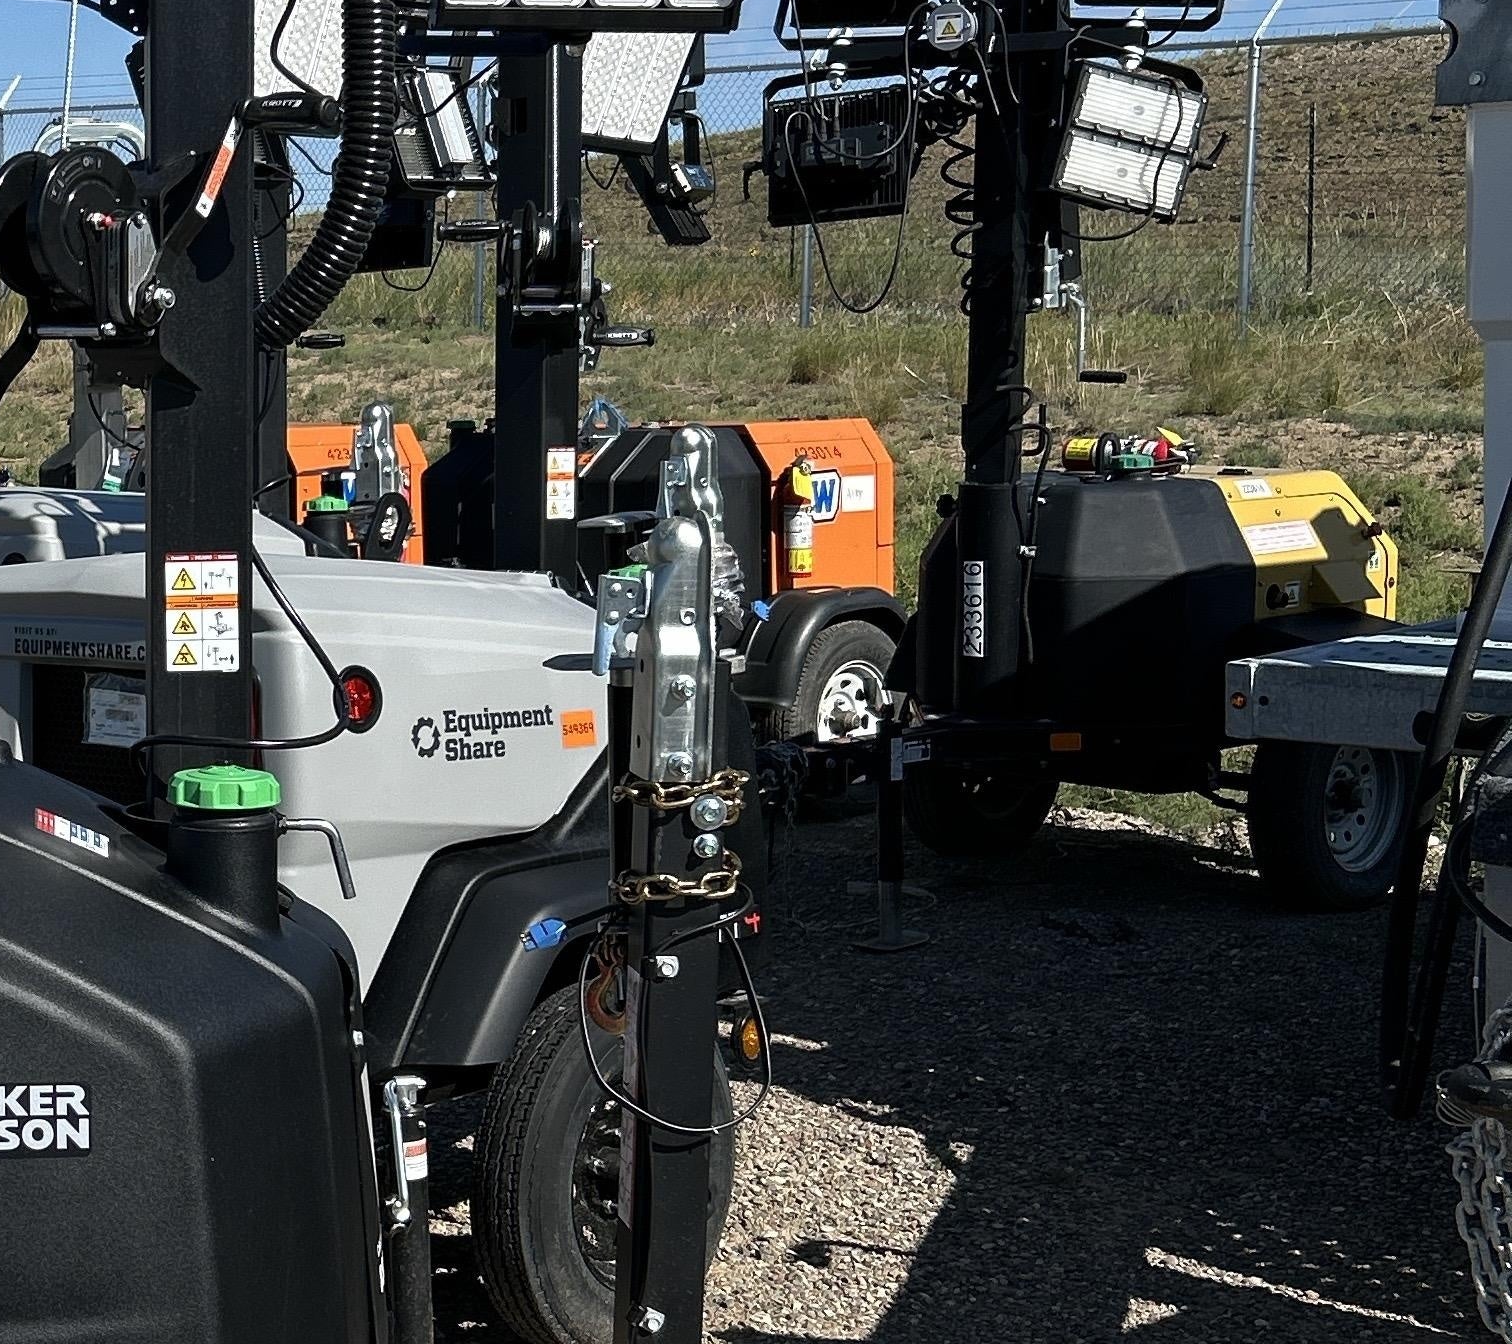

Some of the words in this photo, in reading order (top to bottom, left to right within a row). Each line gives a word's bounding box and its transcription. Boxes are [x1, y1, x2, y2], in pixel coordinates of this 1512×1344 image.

[14, 638, 146, 661] EQUIPMENTSHARE.C
[443, 705, 554, 737] Equipment
[445, 738, 506, 762] Share
